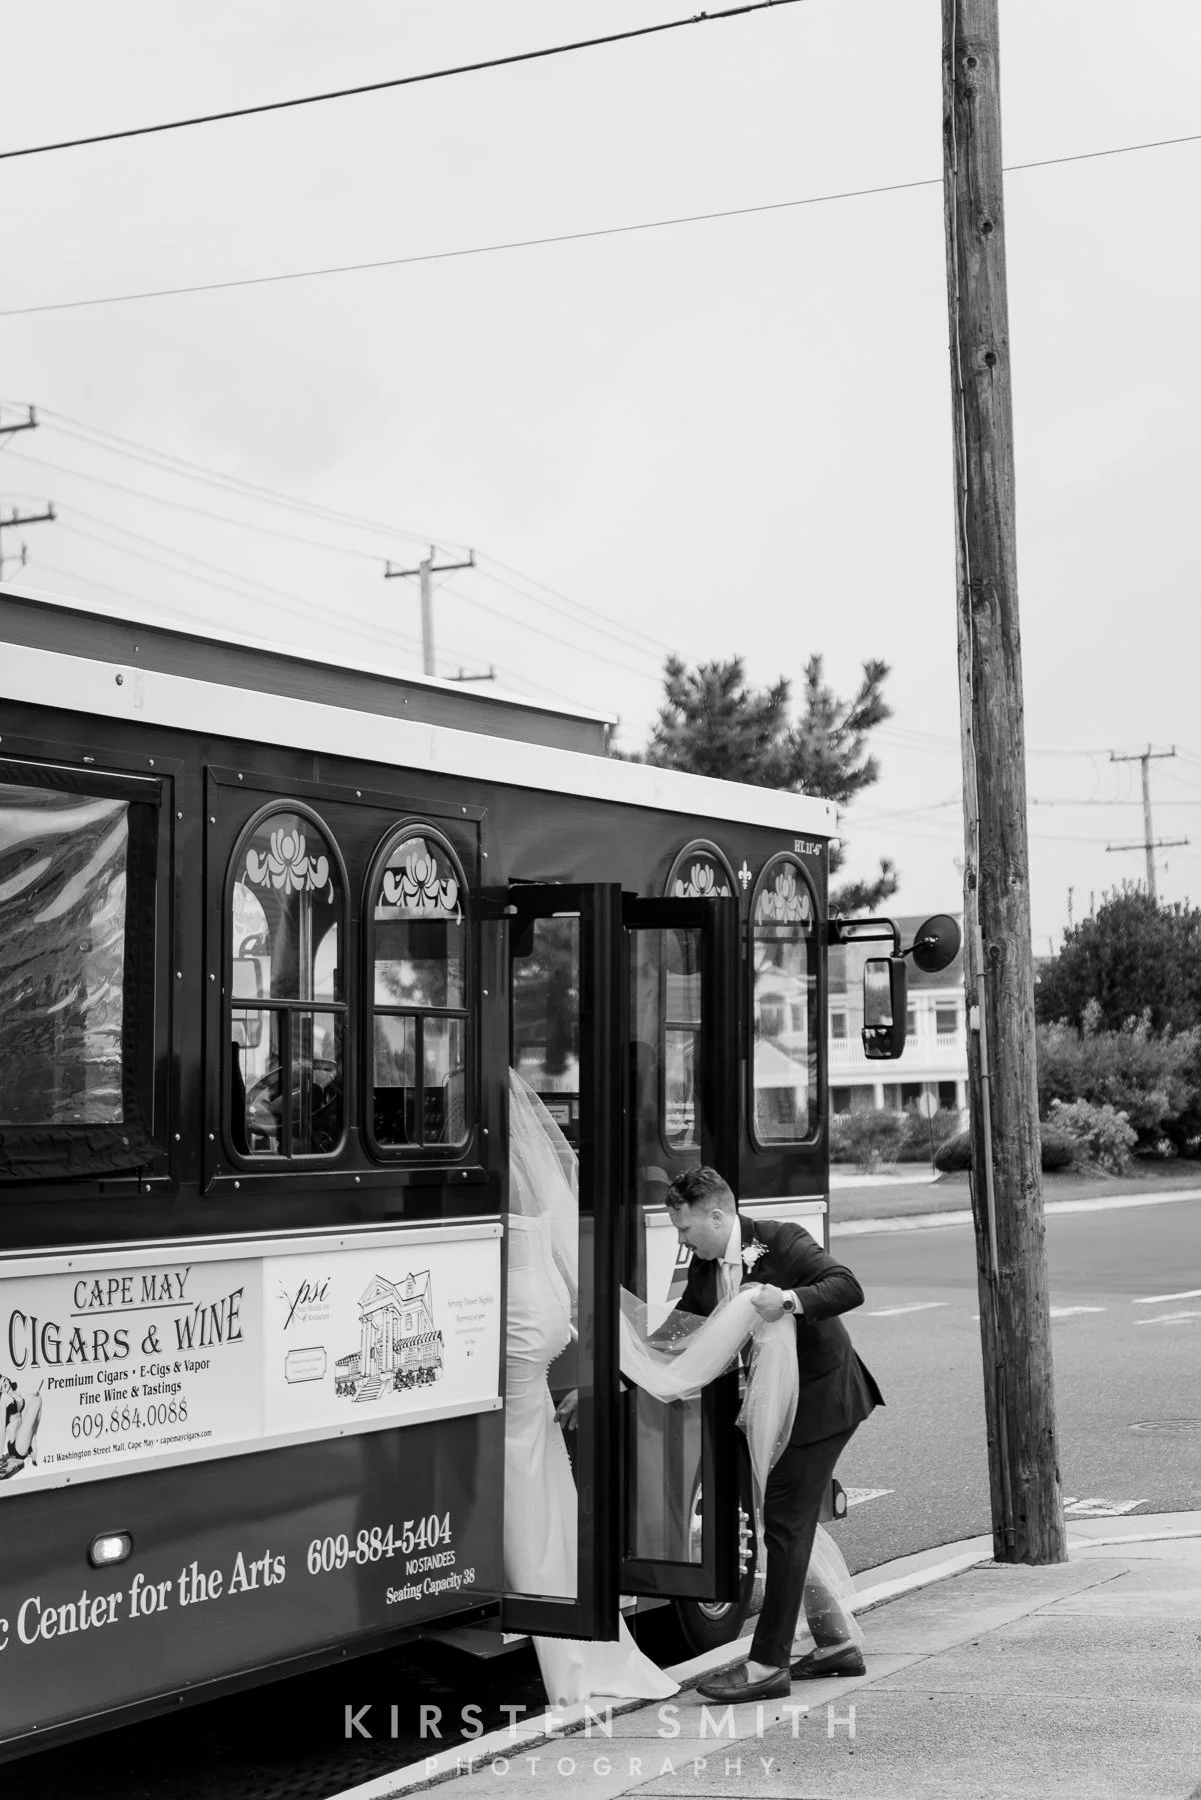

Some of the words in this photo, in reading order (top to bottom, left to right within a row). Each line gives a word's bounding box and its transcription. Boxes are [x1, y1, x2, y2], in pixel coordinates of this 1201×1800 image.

[73, 1277, 134, 1309] CAPE
[141, 1265, 192, 1302] MAY
[8, 1309, 131, 1370] CIGARS
[141, 1324, 162, 1355] &
[174, 1287, 245, 1352] WINE
[47, 1373, 94, 1390] Premium
[97, 1369, 129, 1385] Cigars
[140, 1363, 171, 1379] E-Cigs
[173, 1361, 182, 1373] &
[184, 1359, 211, 1374] Vapor
[79, 1391, 101, 1406] Fine
[104, 1388, 128, 1402] Wine
[130, 1385, 140, 1398] &
[142, 1381, 182, 1397] Tastings
[71, 1396, 188, 1439] 609.884.0088
[56, 1449, 92, 1464] Washington
[93, 1445, 112, 1456] Street
[128, 1441, 142, 1452] Cape
[143, 1439, 154, 1449] May
[160, 1429, 213, 1446] capemaycigars.com
[307, 1511, 452, 1575] 609-884-5404
[405, 1559, 419, 1576] NO
[418, 1550, 456, 1573] STANDEES
[17, 1589, 123, 1645] Center
[129, 1573, 172, 1618] for
[177, 1561, 223, 1606] the
[228, 1549, 286, 1595] Arts
[386, 1583, 423, 1605] Seating
[423, 1572, 463, 1596] Capacity
[463, 1567, 476, 1585] 38
